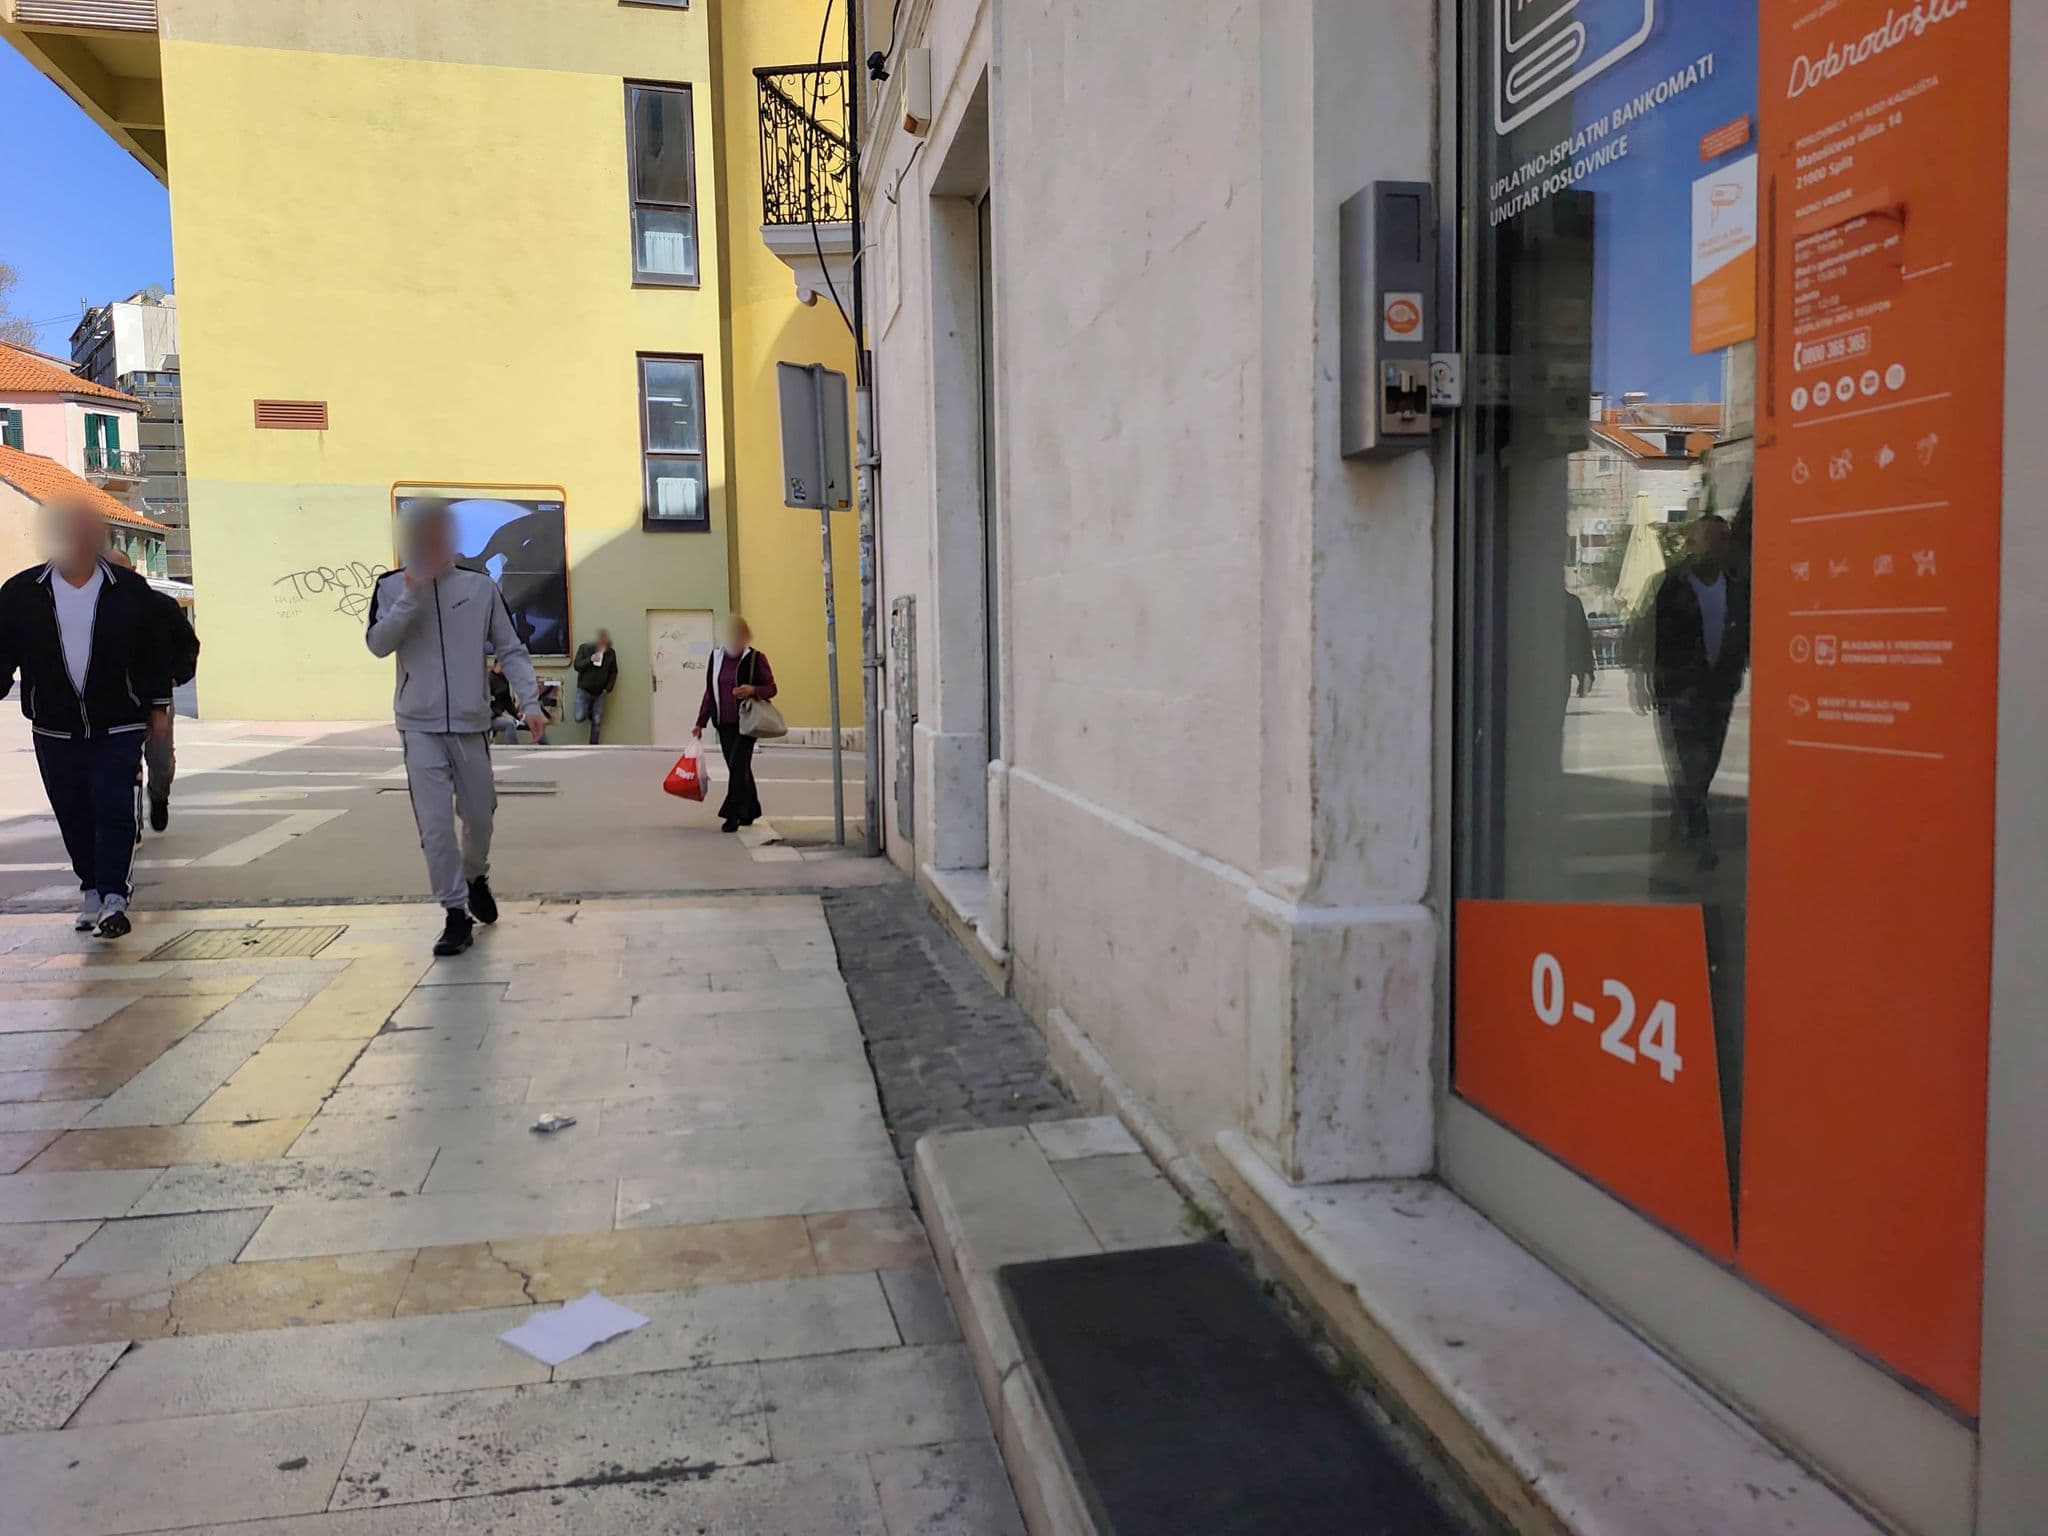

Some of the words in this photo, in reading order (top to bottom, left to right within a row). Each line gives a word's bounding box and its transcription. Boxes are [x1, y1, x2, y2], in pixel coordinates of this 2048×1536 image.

[1489, 116, 1609, 201] UPLATNO-ISPLATNI
[1612, 53, 1714, 130] BANKOMATI
[1489, 185, 1540, 227] UNUTAR
[1542, 135, 1628, 200] POSLOVNICE
[1531, 952, 1683, 1084] 0-24
